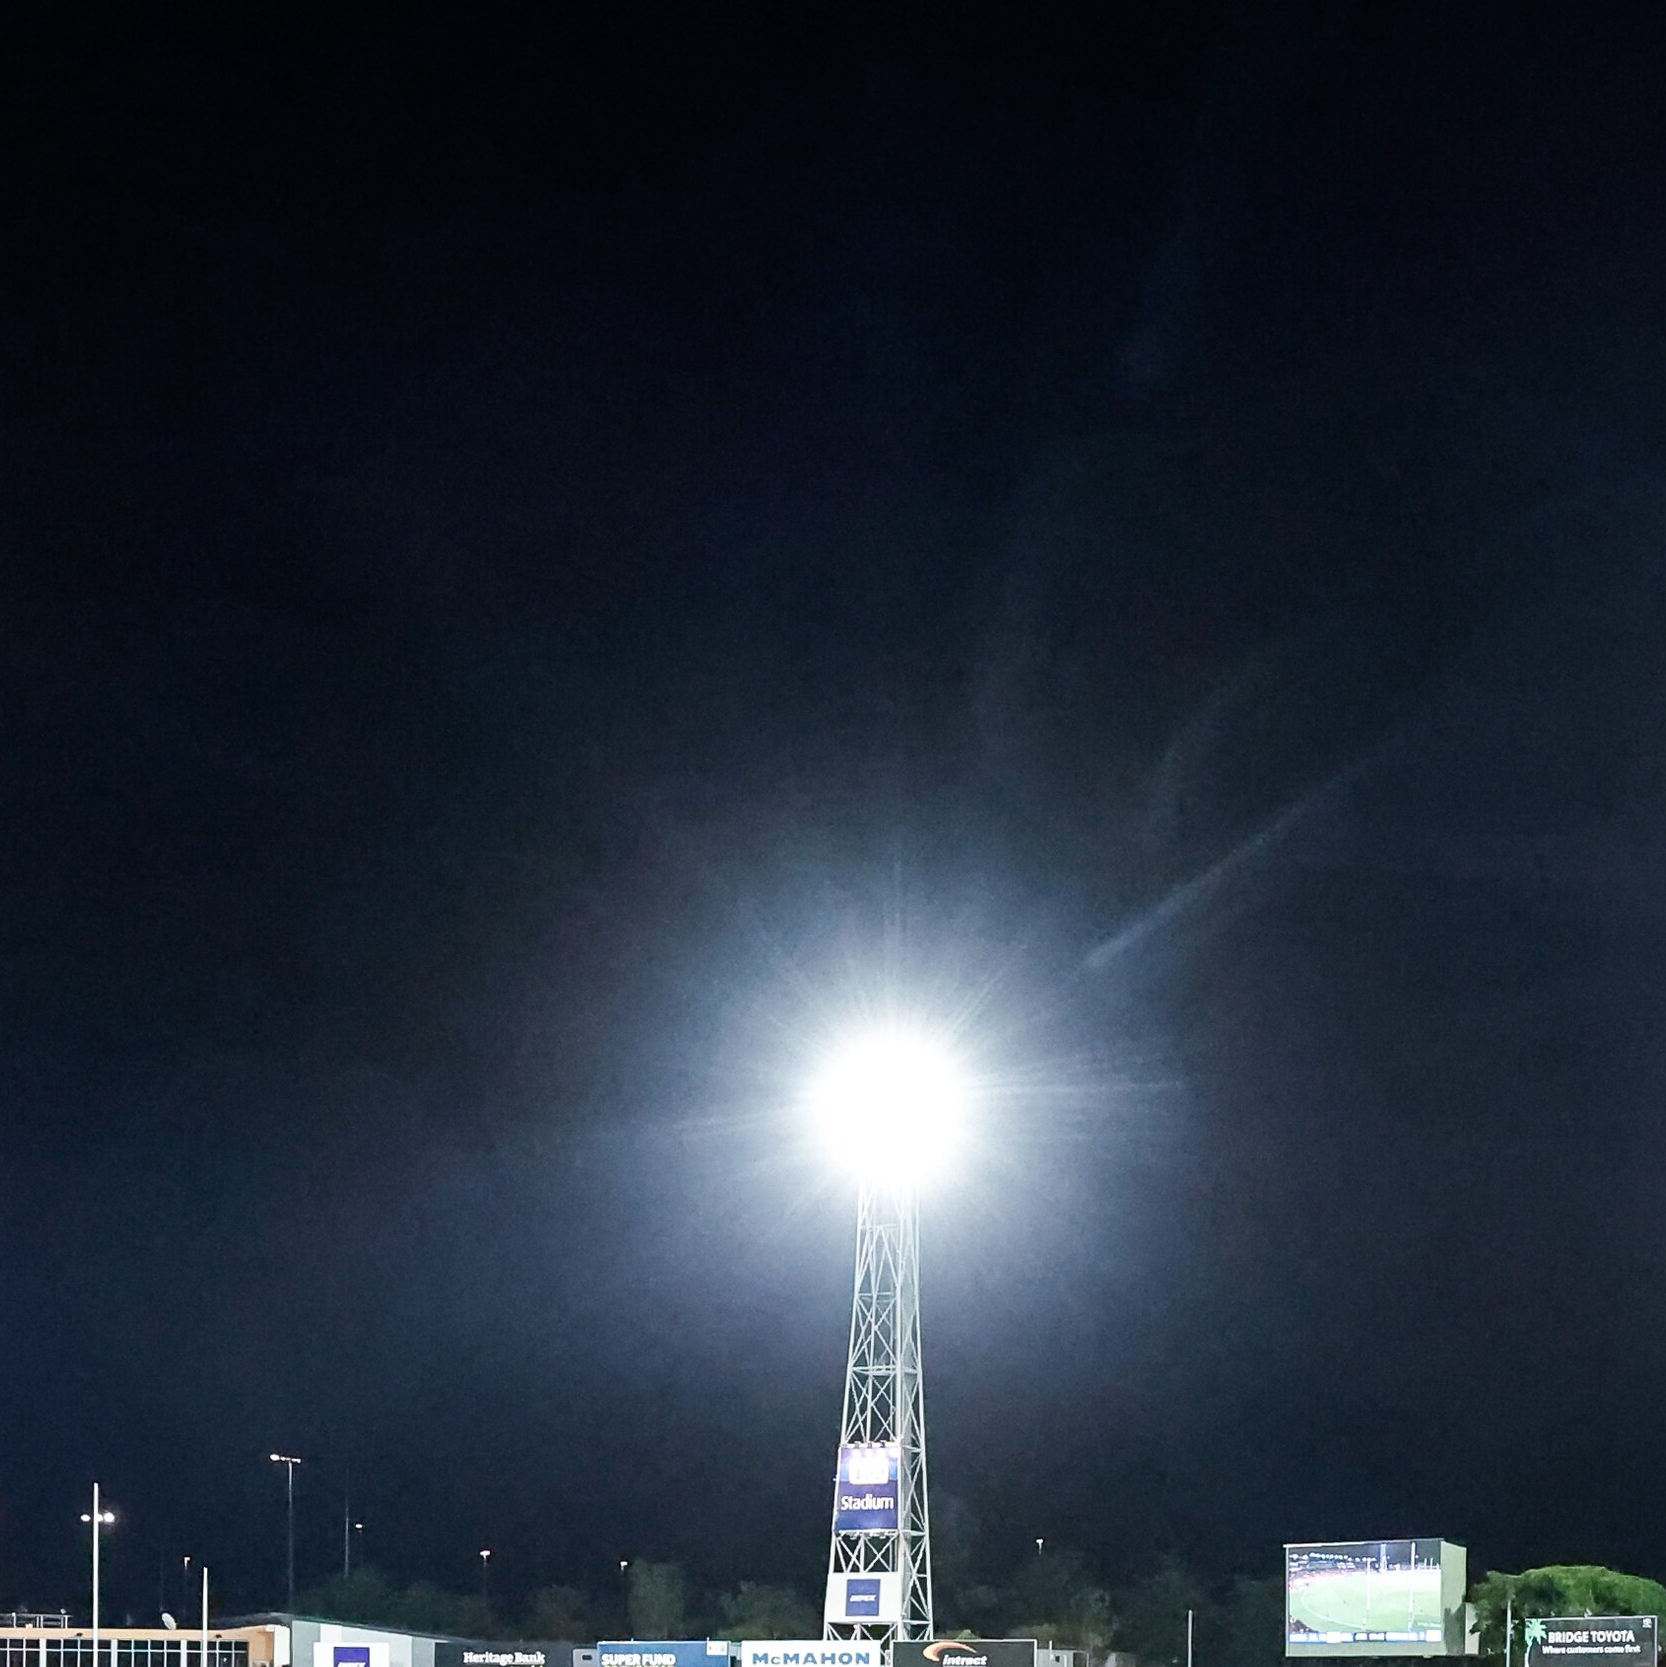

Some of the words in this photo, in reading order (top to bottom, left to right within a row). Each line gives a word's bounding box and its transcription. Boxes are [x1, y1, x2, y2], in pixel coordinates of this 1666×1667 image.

[840, 1493, 894, 1511] Stadium
[1547, 1630, 1589, 1643] BRIDGE
[1590, 1629, 1636, 1643] TOYOTA
[1541, 1645, 1566, 1655] Where
[1566, 1645, 1603, 1654] customers
[1604, 1645, 1624, 1654] come
[463, 1651, 513, 1666] Heritage
[514, 1651, 546, 1664] Bank
[601, 1653, 641, 1666] SUPER
[642, 1653, 676, 1666] FUND
[752, 1652, 871, 1665] McMAHON
[942, 1654, 988, 1666] intract
